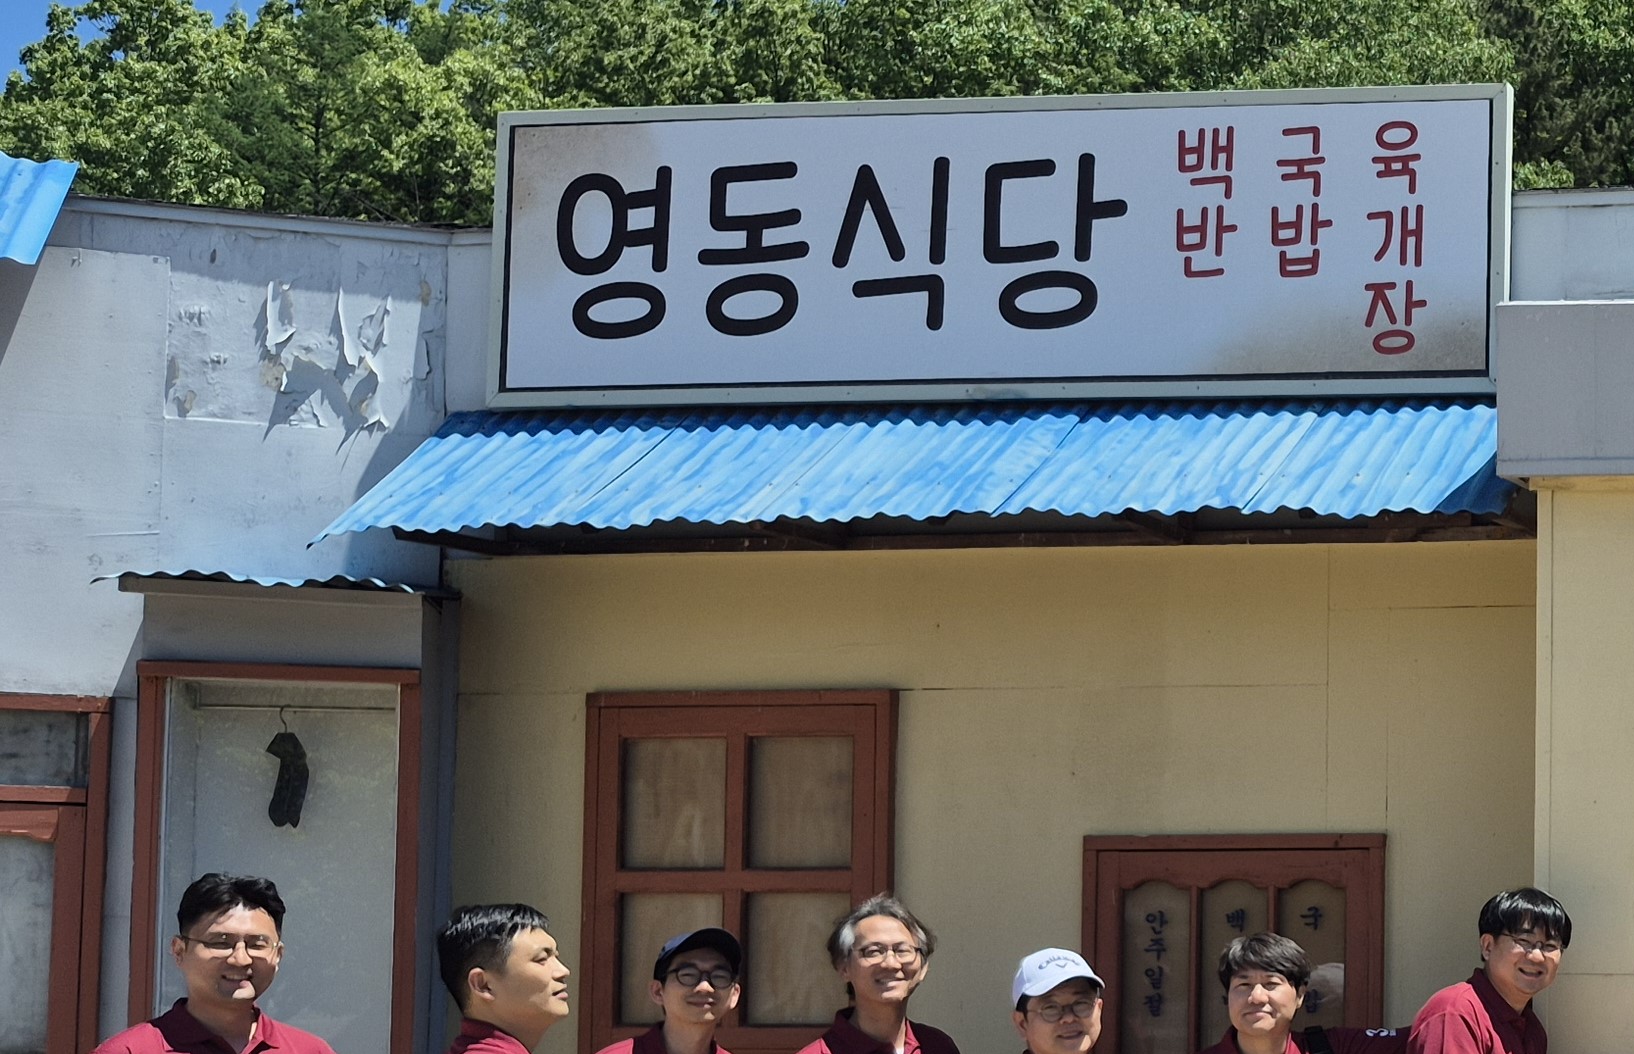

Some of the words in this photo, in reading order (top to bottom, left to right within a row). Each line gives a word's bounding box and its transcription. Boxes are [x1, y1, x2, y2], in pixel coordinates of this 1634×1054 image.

[557, 153, 1127, 339] 영동식당
[1177, 126, 1238, 278] 백반
[1271, 126, 1333, 278] 국밥
[1364, 121, 1428, 355] 육개장
